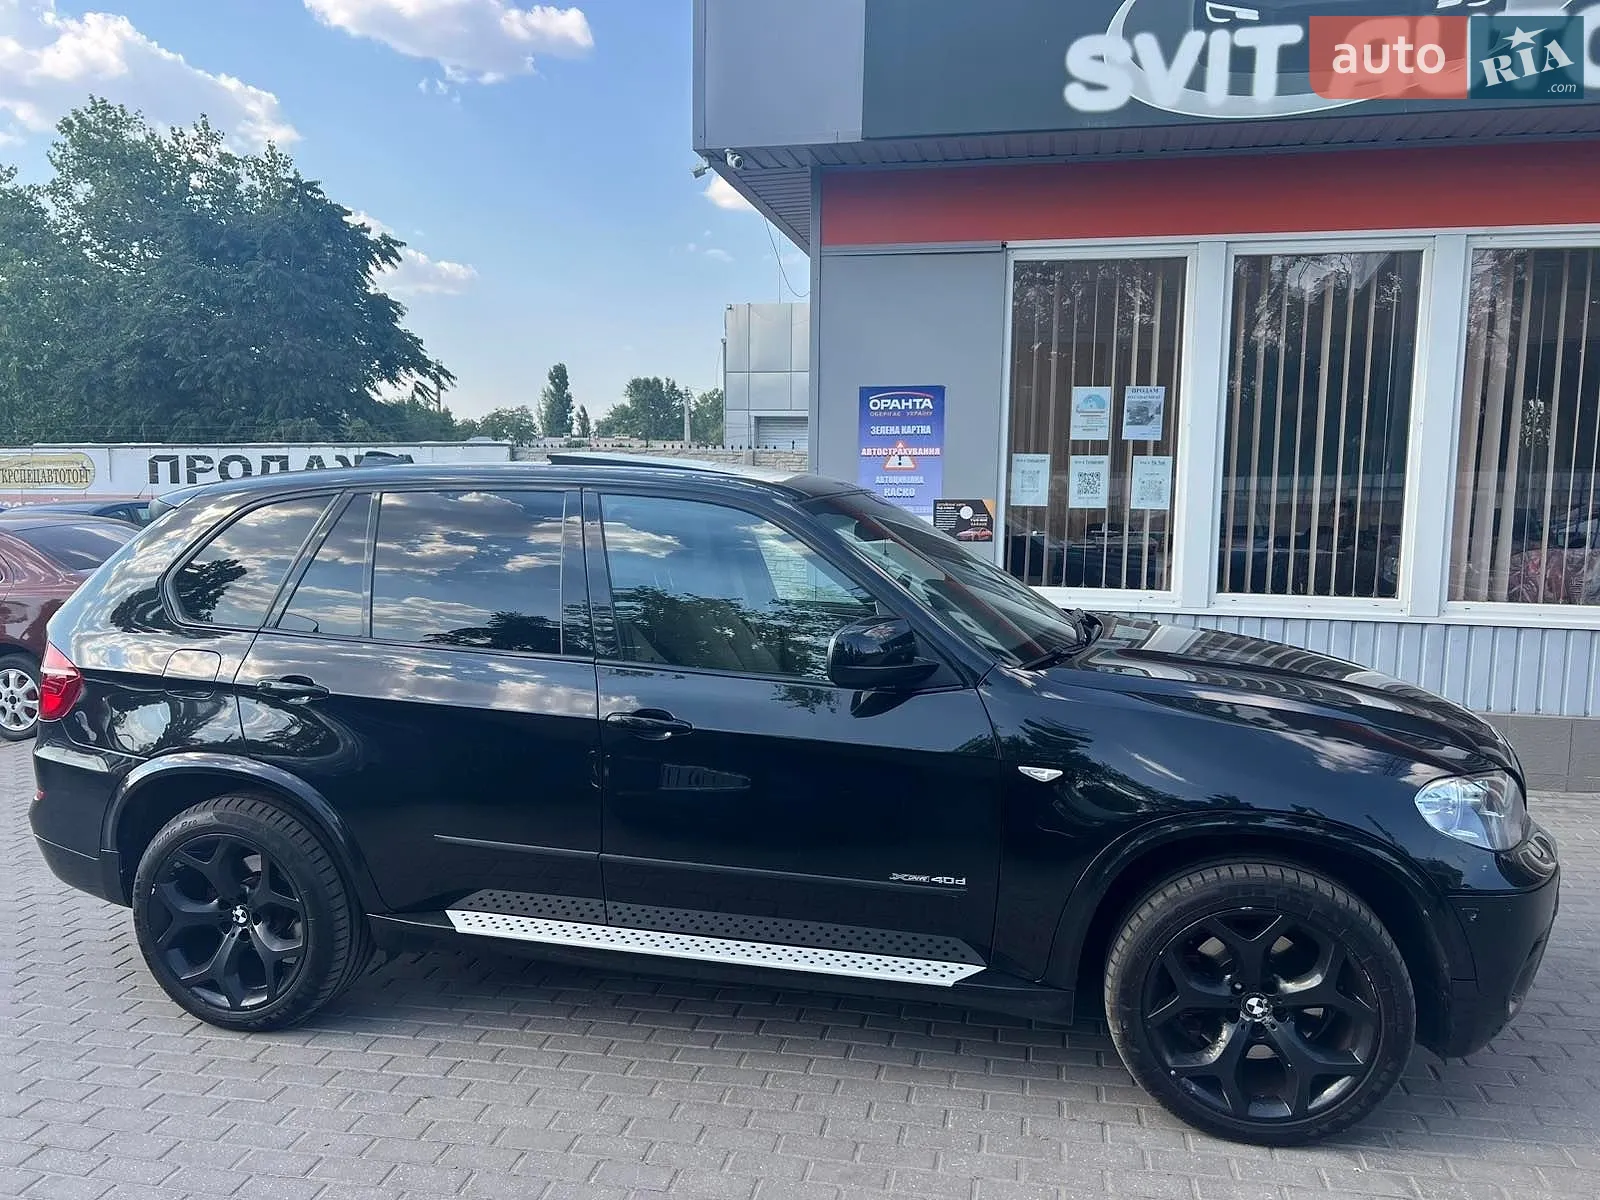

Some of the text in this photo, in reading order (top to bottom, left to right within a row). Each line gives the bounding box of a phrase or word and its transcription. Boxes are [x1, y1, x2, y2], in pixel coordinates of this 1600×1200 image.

[1064, 25, 1303, 111] SVIT
[869, 398, 934, 410] ОРАНТА
[870, 425, 932, 435] ЗЕЛЕНА КАРТКА
[861, 447, 941, 456] АВТОСТРАХУВАННЯ
[0, 468, 91, 485] КРСПЕЦАВТОТОРГ
[884, 488, 916, 498] КАСКО
